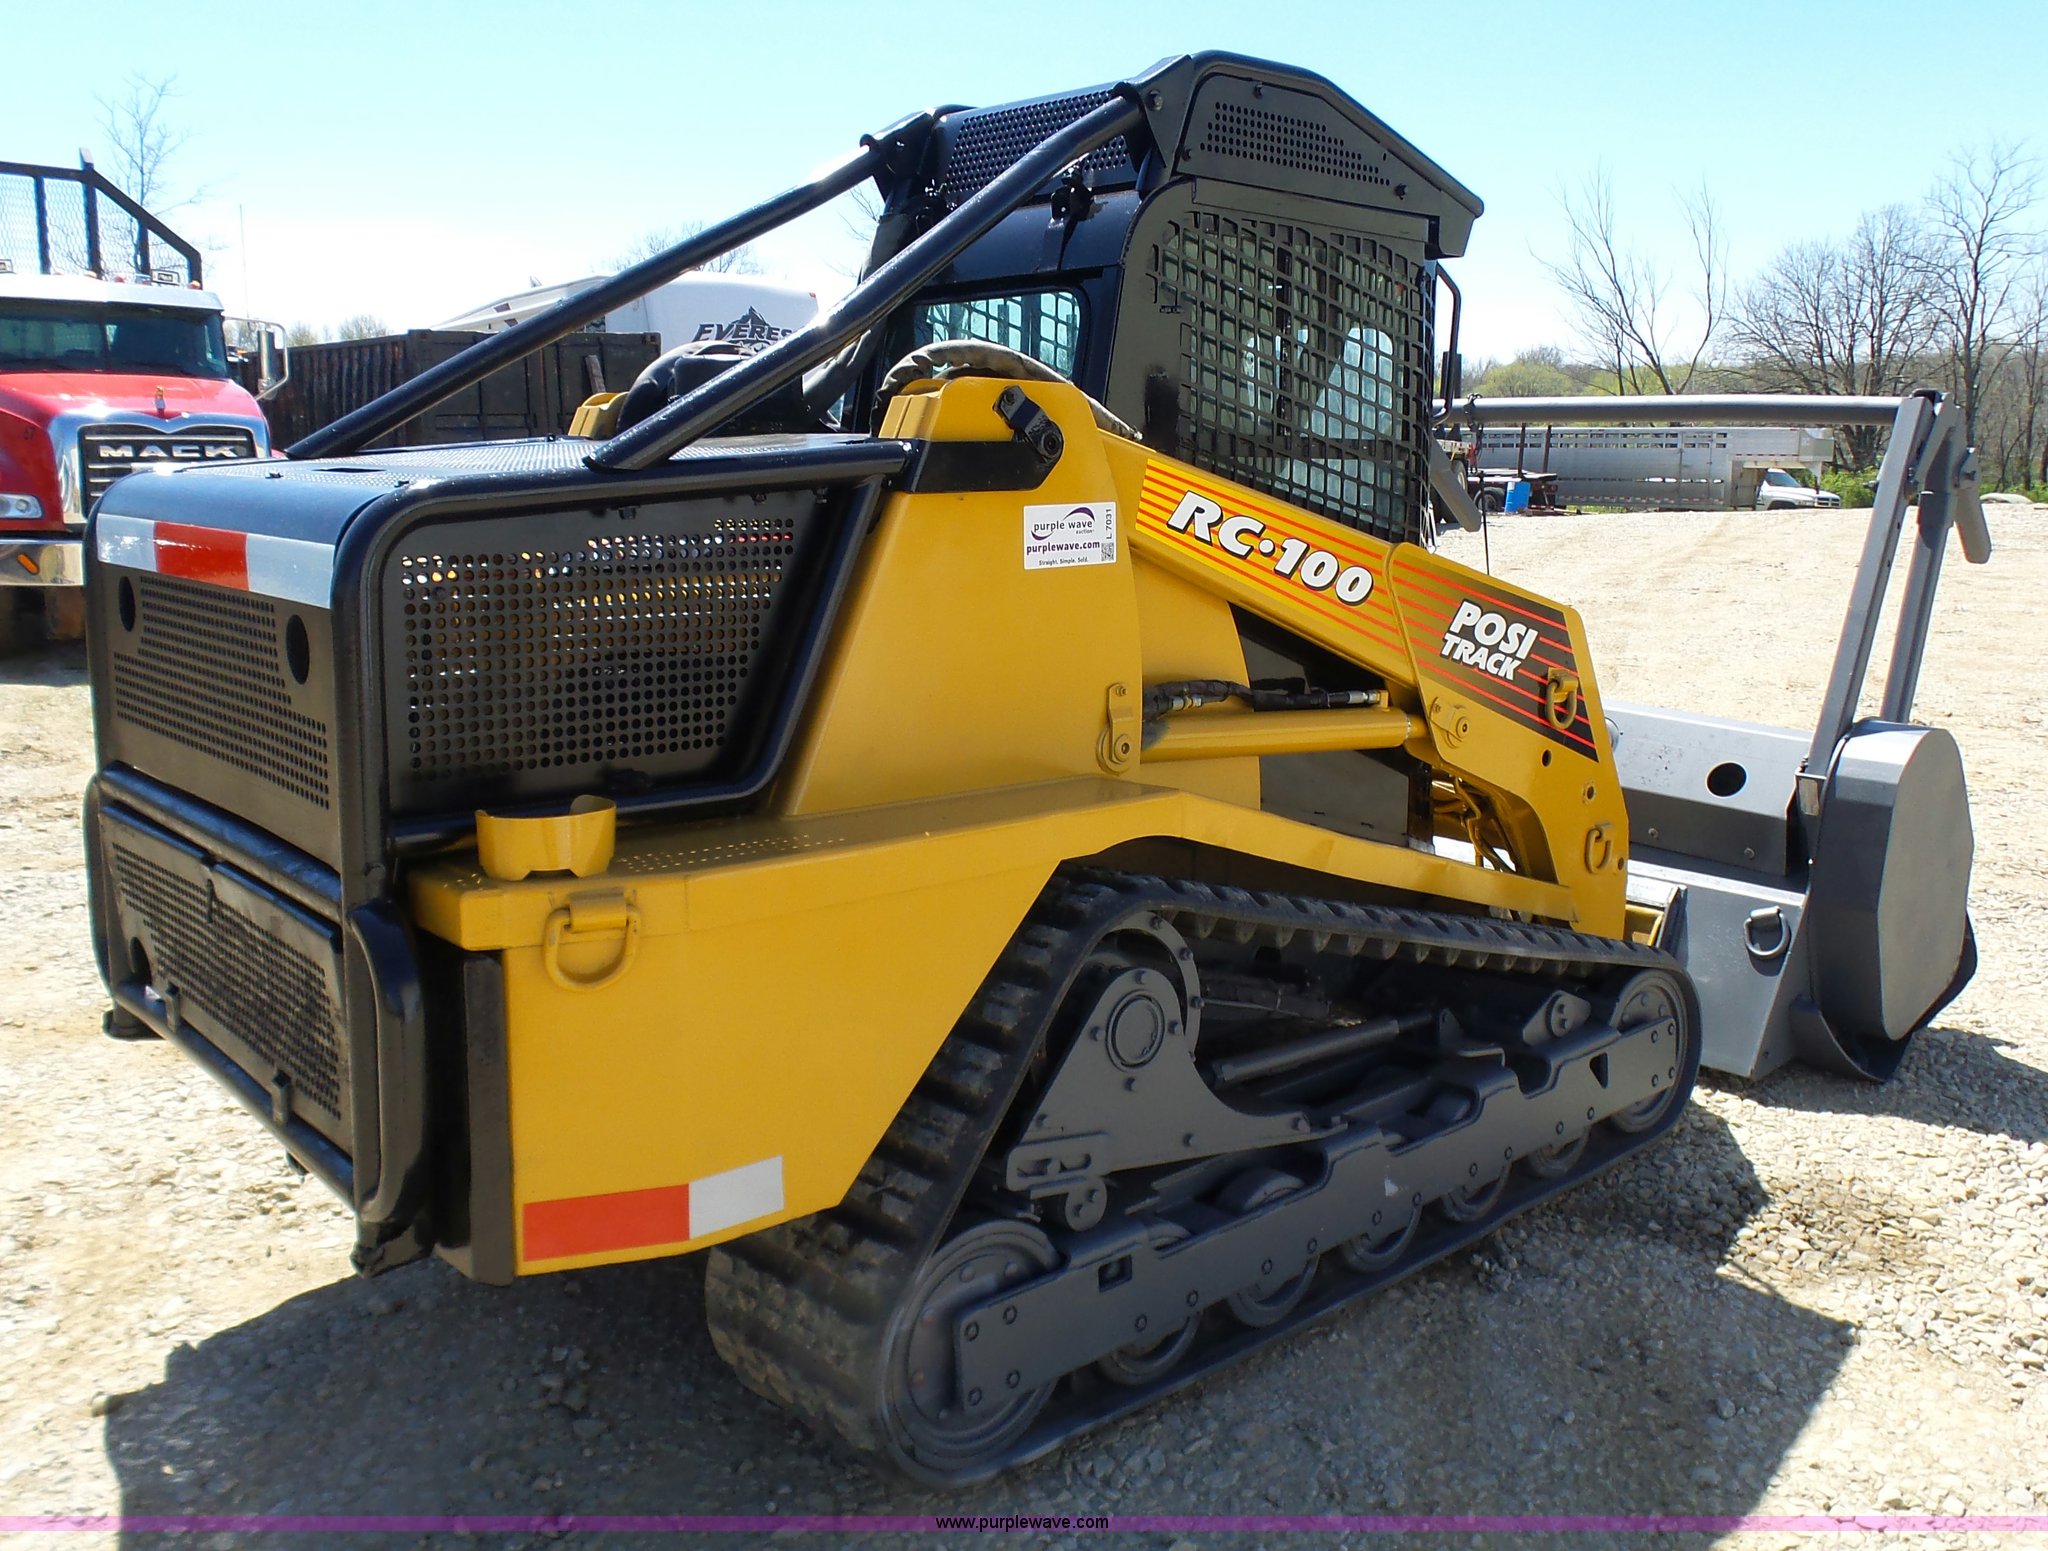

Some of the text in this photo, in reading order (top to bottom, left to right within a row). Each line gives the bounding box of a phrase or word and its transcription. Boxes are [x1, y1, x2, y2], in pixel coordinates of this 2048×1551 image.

[692, 323, 793, 343] EVERES
[99, 444, 238, 459] MACK
[1034, 520, 1093, 532] purple wave
[1026, 541, 1100, 556] purplewave.com
[1448, 599, 1540, 660] POSI
[1440, 632, 1522, 681] TRACK
